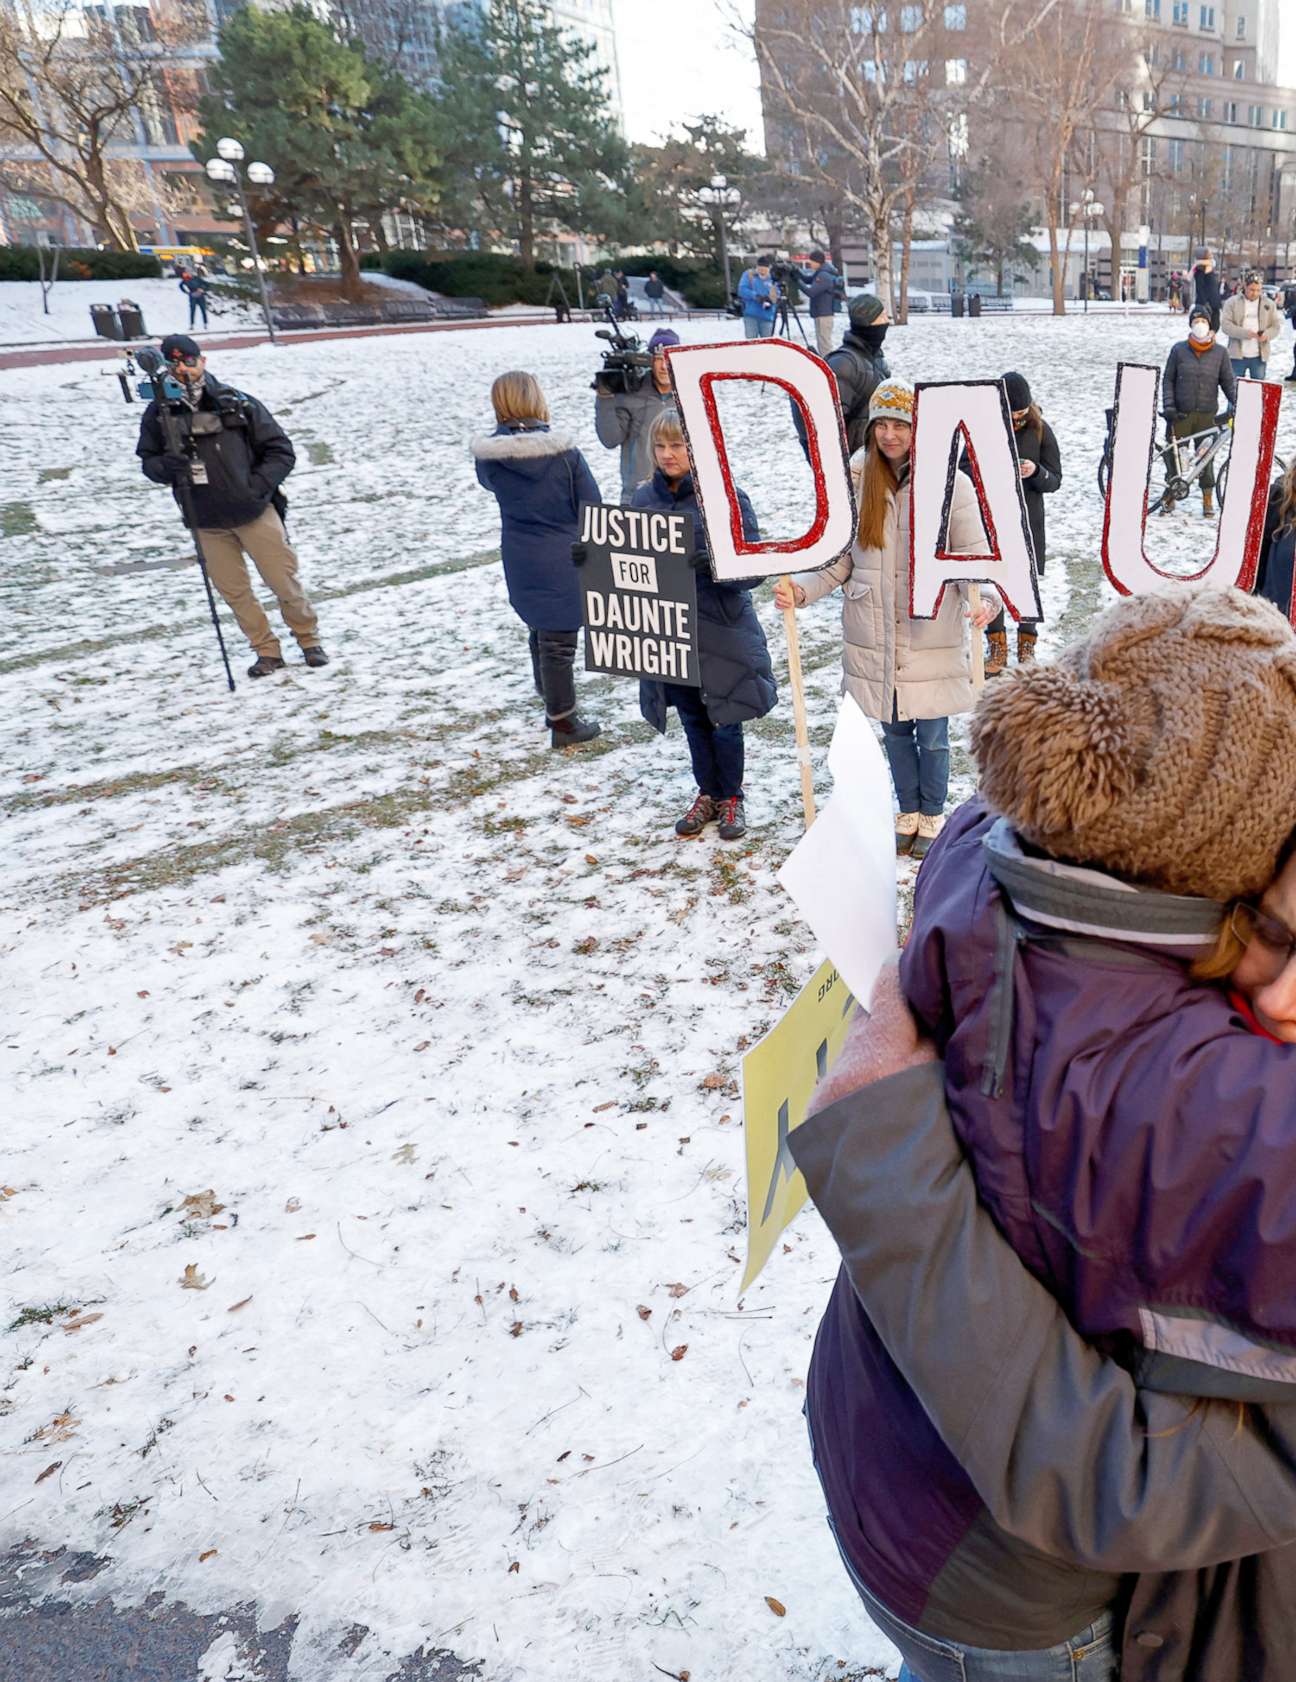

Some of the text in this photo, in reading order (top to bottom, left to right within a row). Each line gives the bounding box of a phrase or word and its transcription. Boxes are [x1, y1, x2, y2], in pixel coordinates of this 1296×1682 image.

[581, 505, 686, 554] JUSTICE
[619, 560, 651, 585] FOR
[586, 590, 691, 639] DAUNTE
[590, 630, 692, 679] WRIGHT
